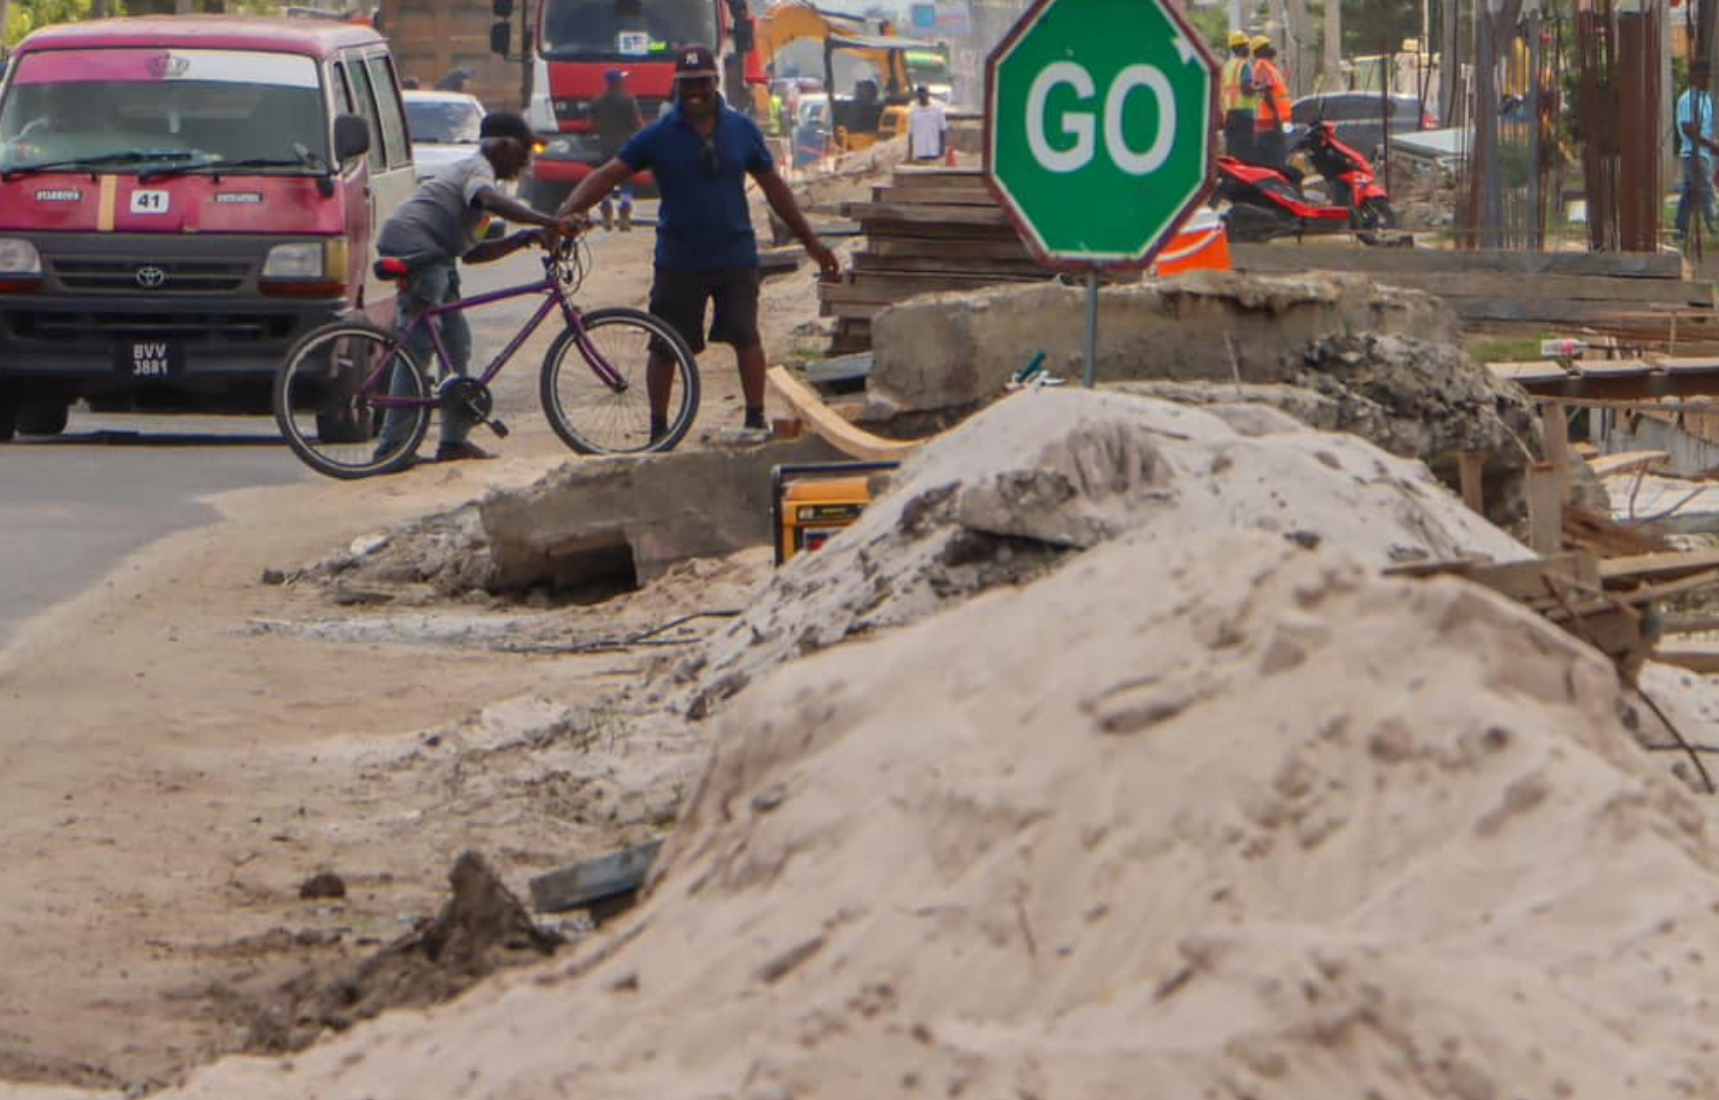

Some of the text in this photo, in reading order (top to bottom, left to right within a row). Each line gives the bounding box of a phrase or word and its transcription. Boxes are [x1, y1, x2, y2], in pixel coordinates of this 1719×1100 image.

[1025, 60, 1178, 176] GO
[137, 192, 160, 209] 41
[133, 343, 167, 359] BVV
